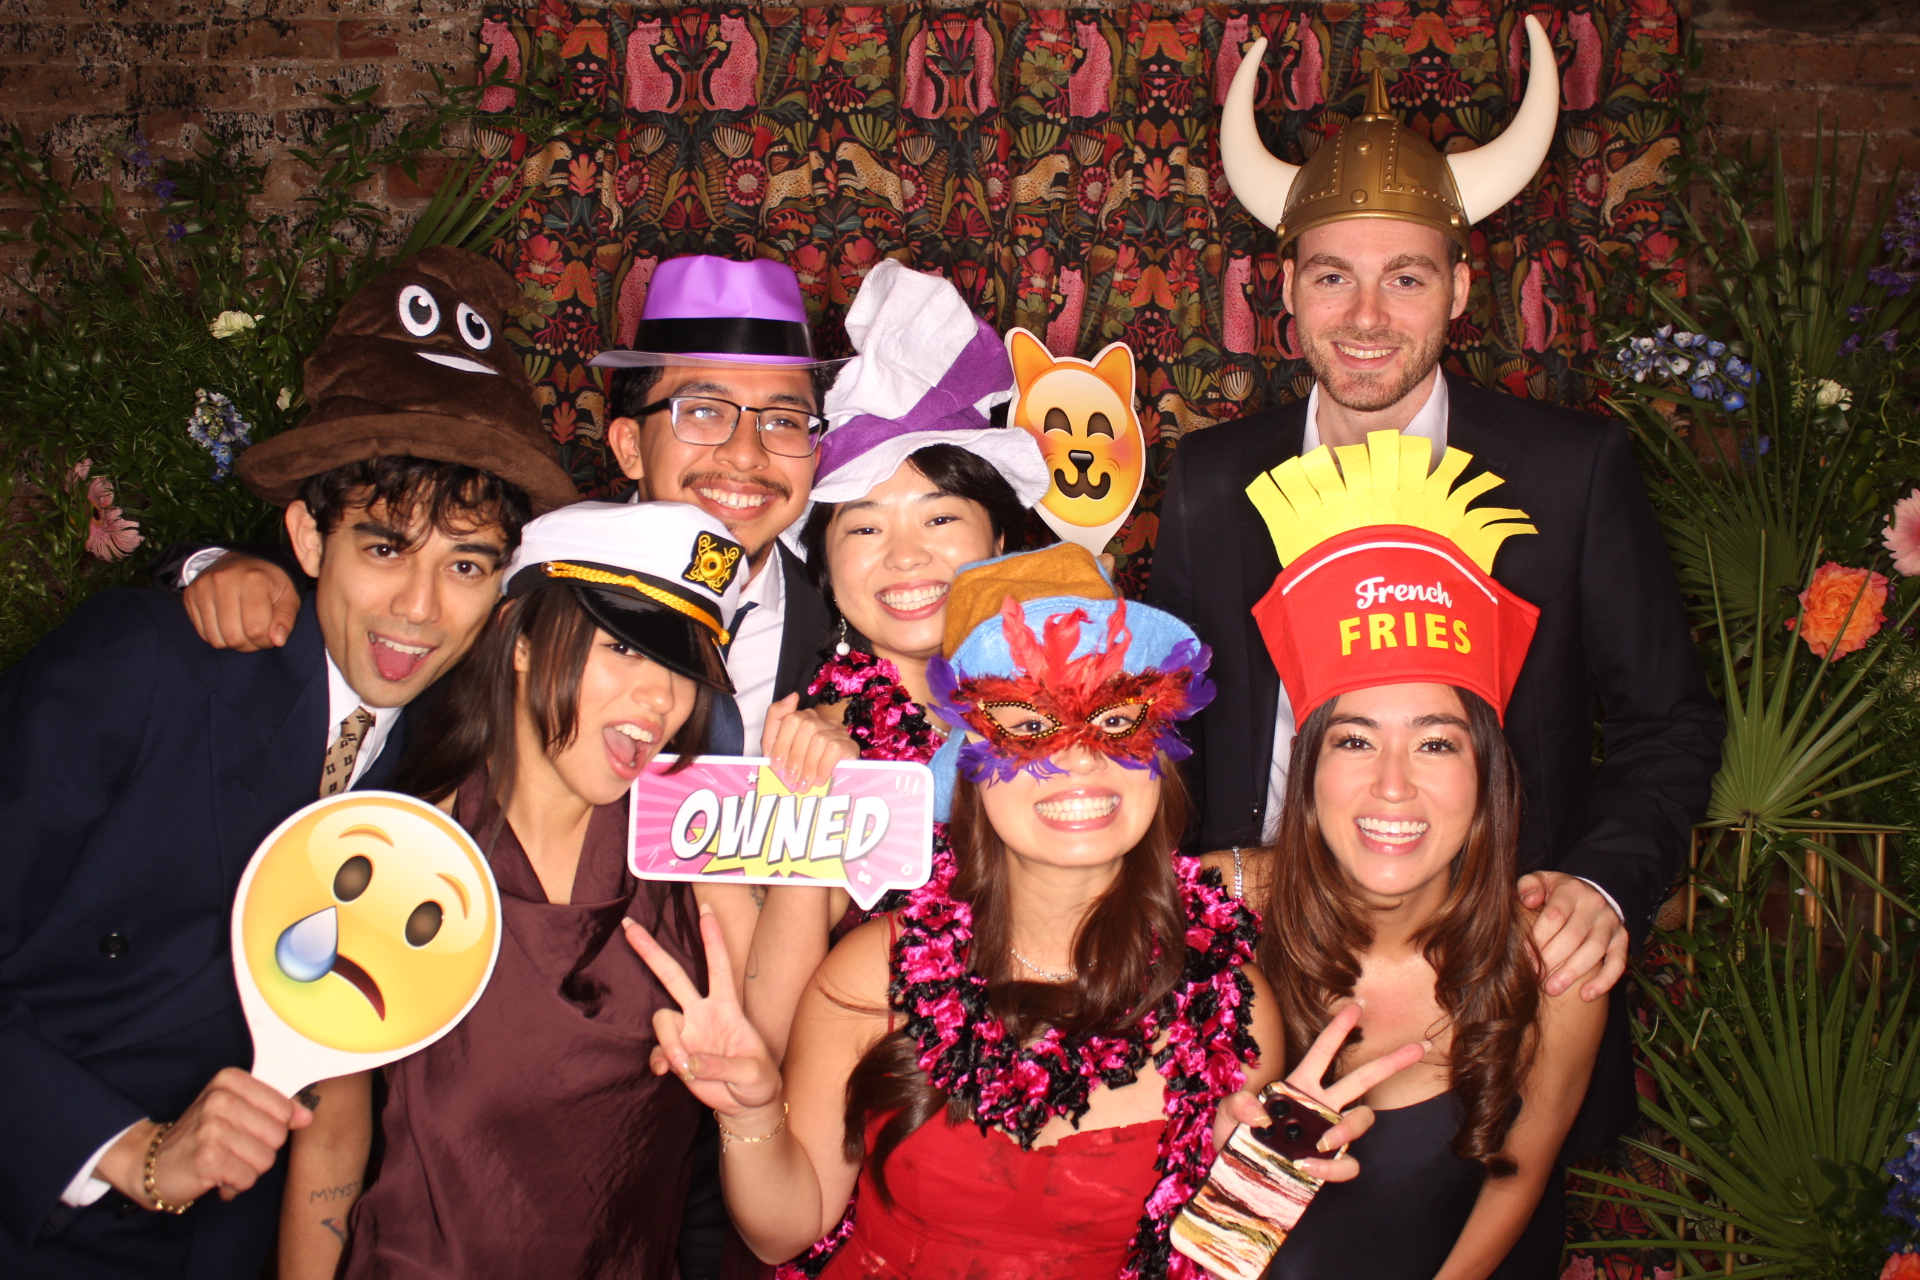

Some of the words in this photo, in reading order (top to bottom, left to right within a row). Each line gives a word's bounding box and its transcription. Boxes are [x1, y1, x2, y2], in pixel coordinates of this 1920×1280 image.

[1355, 576, 1452, 609] French
[1339, 612, 1471, 656] FRIES
[670, 788, 890, 865] OWNED
